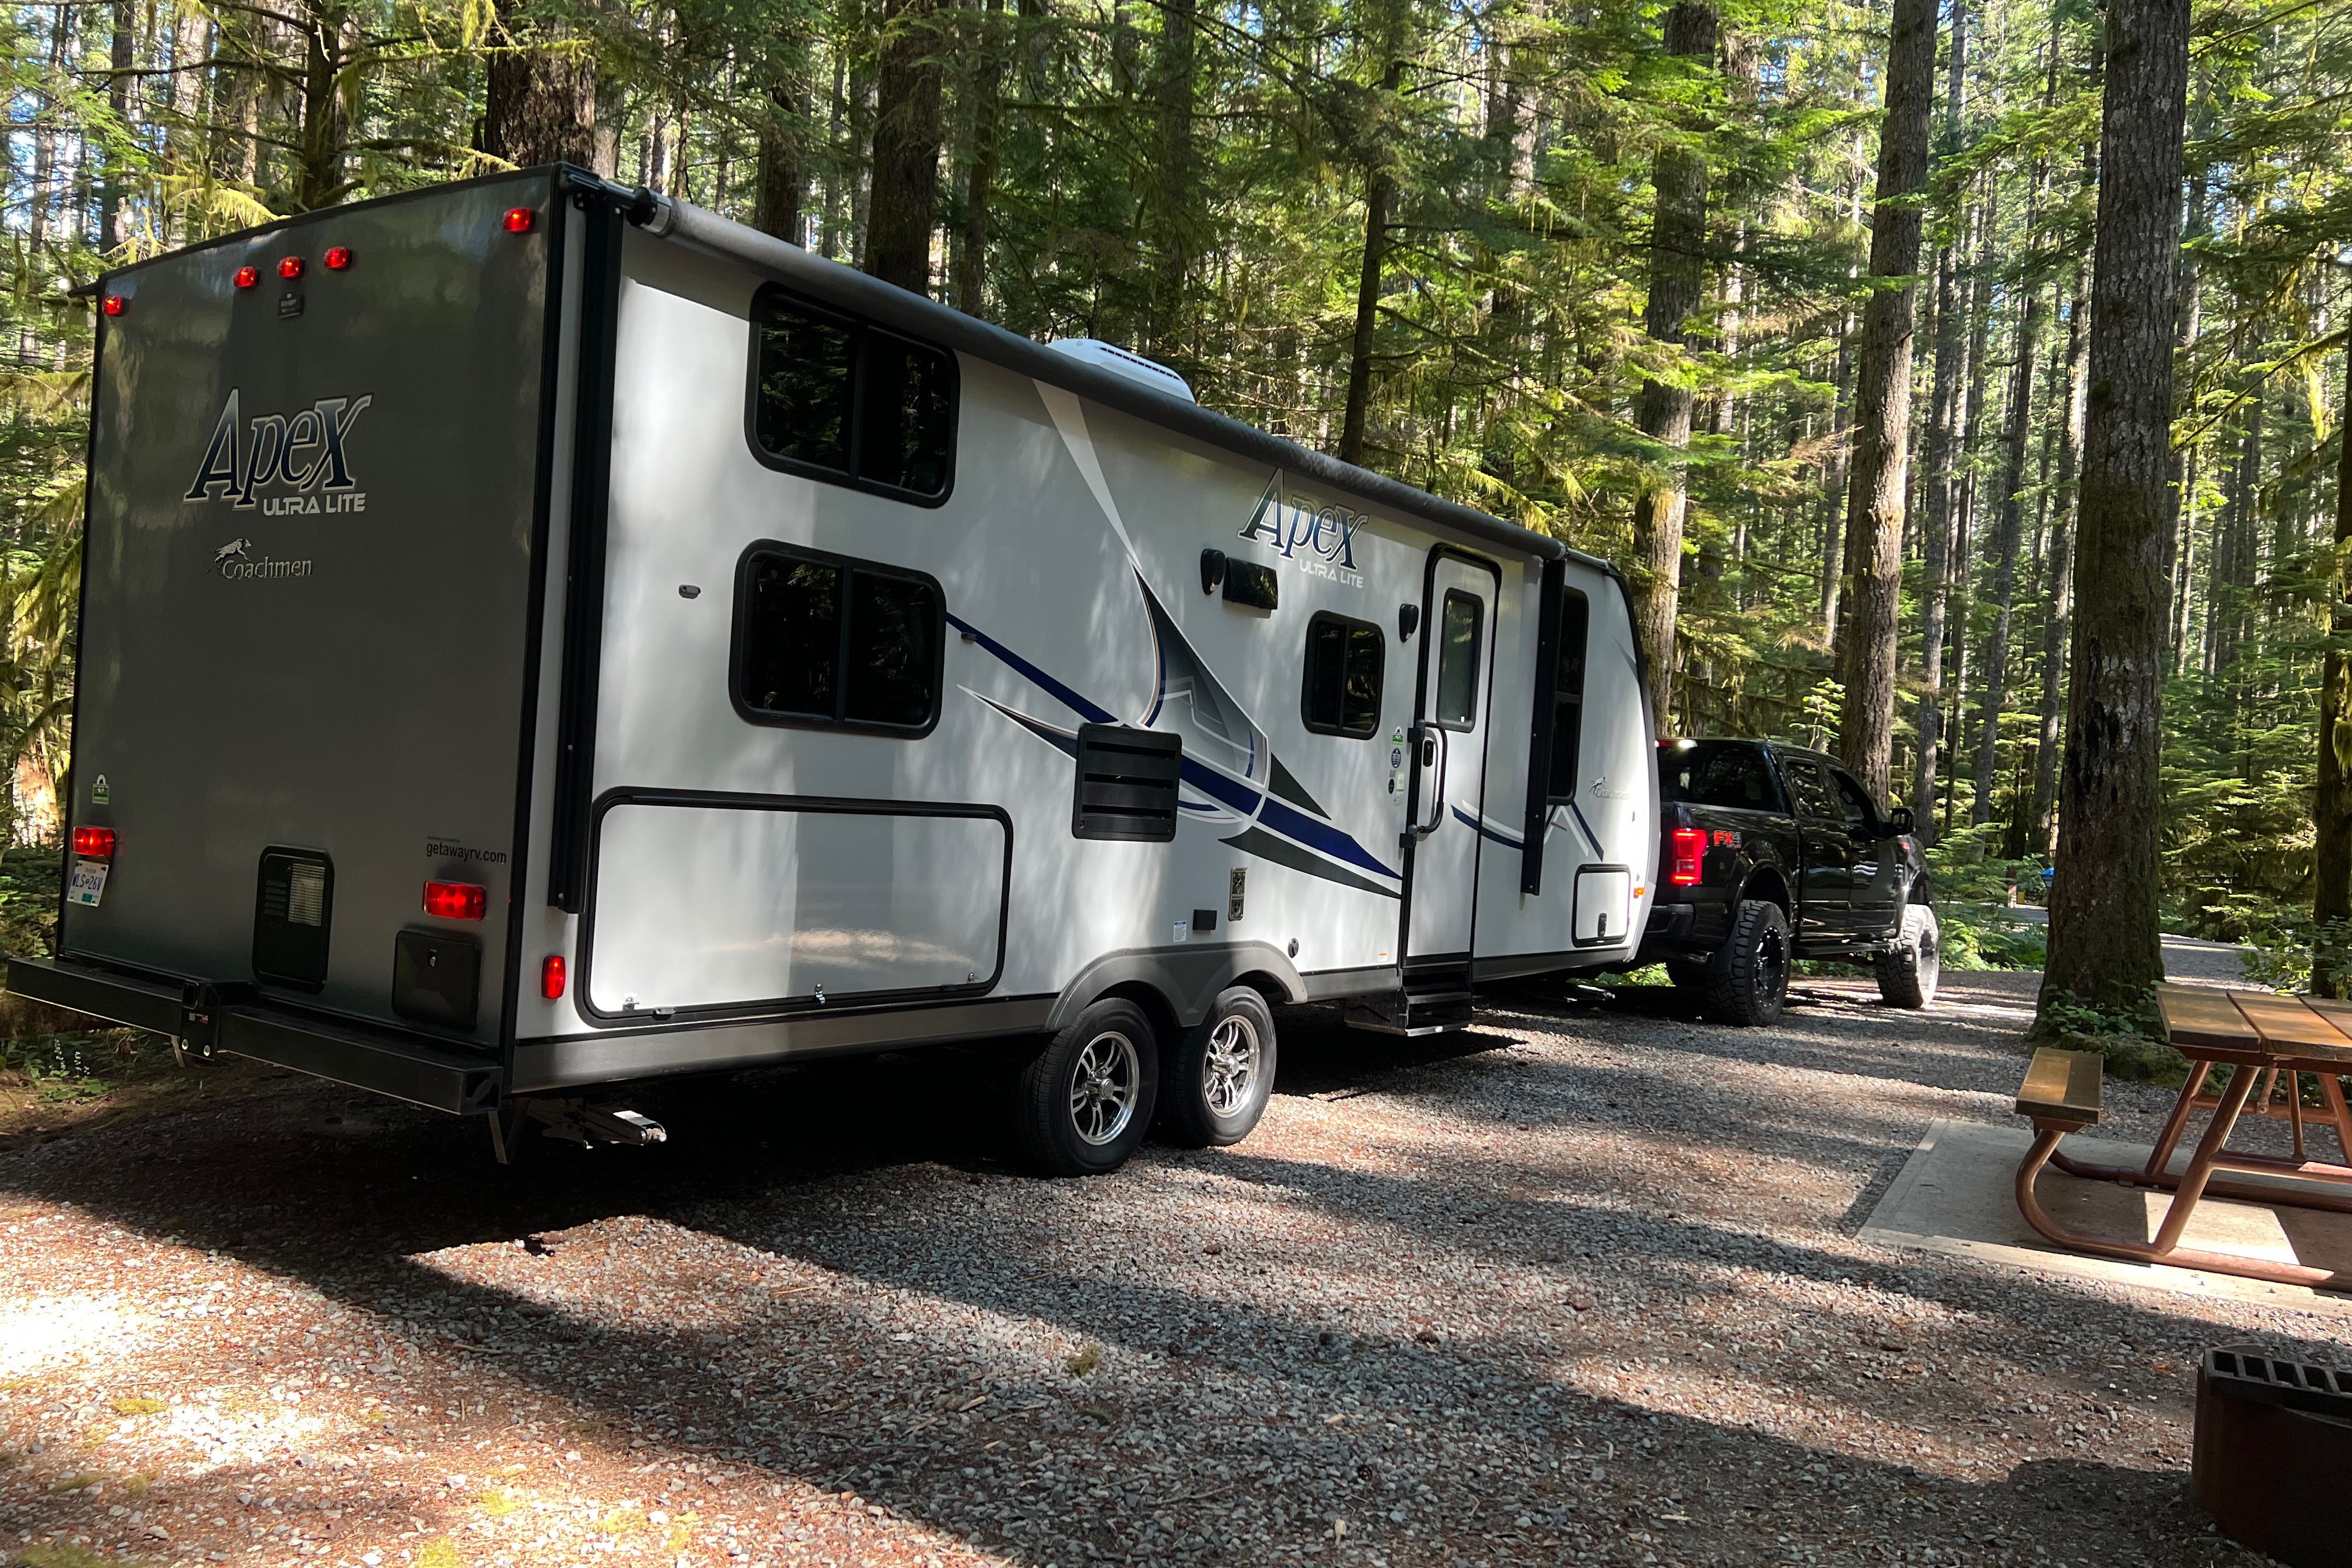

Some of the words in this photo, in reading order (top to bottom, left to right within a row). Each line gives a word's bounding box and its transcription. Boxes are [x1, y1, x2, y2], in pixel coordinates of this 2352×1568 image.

[263, 496, 321, 516] ULTRA
[326, 492, 366, 513] LITE
[222, 555, 313, 580] Coachmen
[1300, 558, 1338, 582] ULTRA
[1340, 570, 1364, 589] LITE
[1714, 830, 1742, 846] FX4
[426, 842, 507, 863] getawayrv.com
